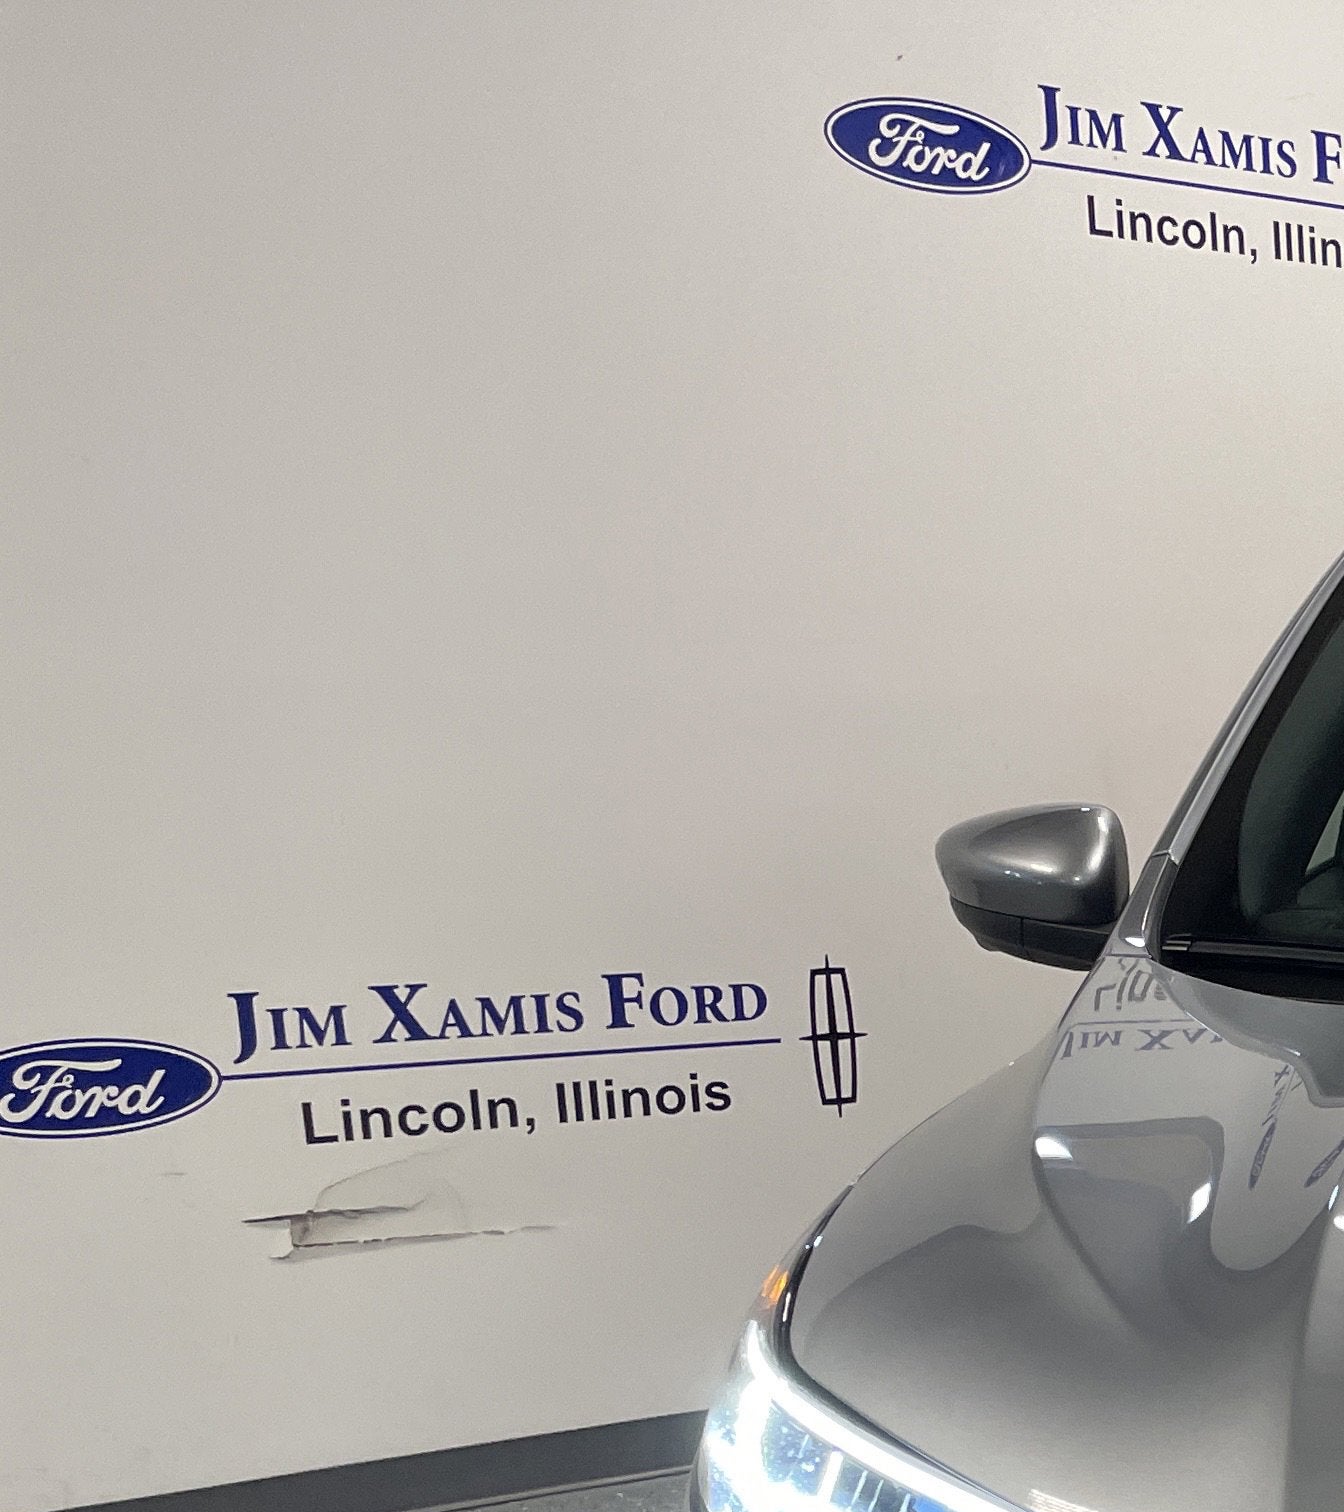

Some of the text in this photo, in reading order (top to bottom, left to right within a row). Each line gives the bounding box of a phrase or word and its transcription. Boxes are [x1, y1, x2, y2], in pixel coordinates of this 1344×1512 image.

[867, 112, 992, 183] Ford
[1036, 84, 1126, 153] JIM
[1141, 101, 1298, 179] XAMIS
[1086, 195, 1258, 264] Lincoln,
[226, 972, 769, 1065] JIM XAMIS FORD
[0, 1058, 168, 1122] Ford
[300, 1072, 734, 1147] Lincoln, Illinois
